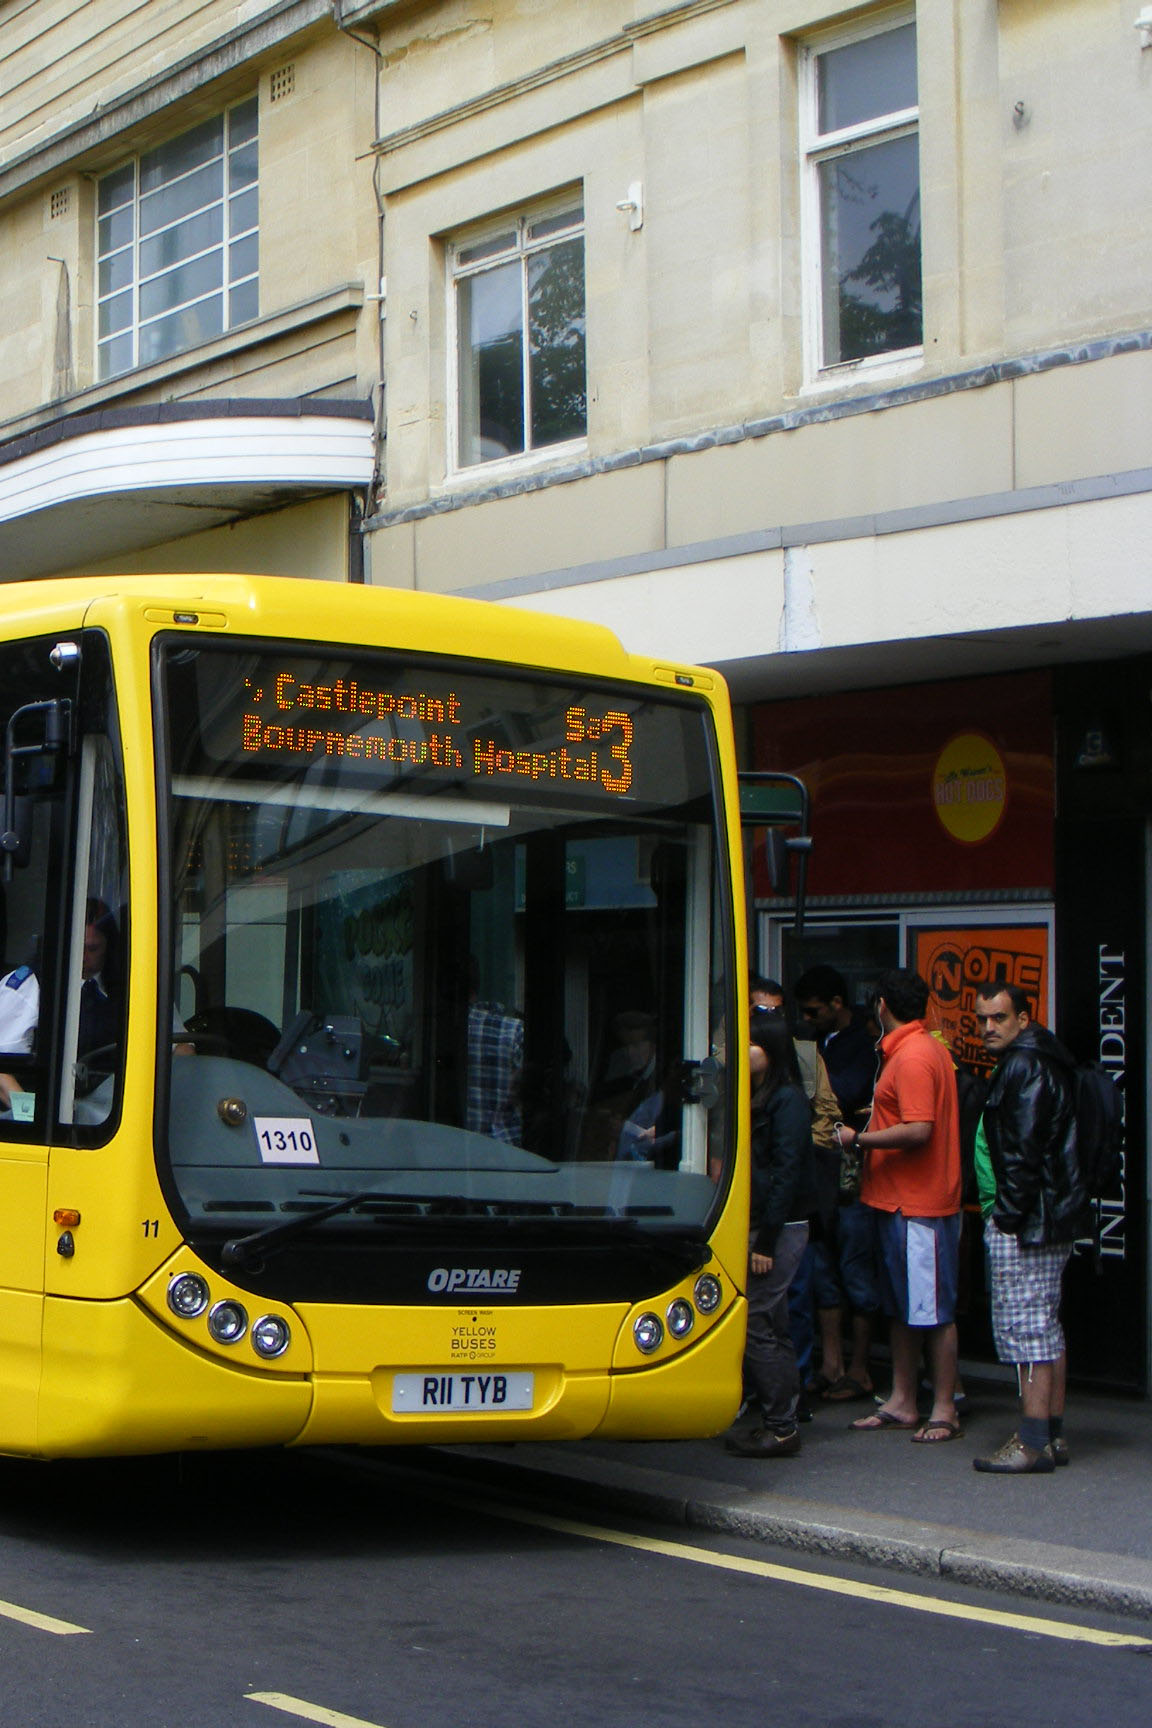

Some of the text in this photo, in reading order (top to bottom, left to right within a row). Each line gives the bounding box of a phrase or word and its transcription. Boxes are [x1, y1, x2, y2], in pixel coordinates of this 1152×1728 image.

[275, 673, 463, 725] Castlepoint
[241, 713, 600, 784] Bournemouth Hospital
[1099, 944, 1127, 1260] INDENT
[260, 1130, 313, 1152] 1310
[141, 1218, 160, 1239] 11
[427, 1268, 522, 1293] OPTARE
[451, 1326, 497, 1337] YELLOW
[451, 1338, 497, 1350] BUSES
[423, 1376, 507, 1405] R11 TYB
